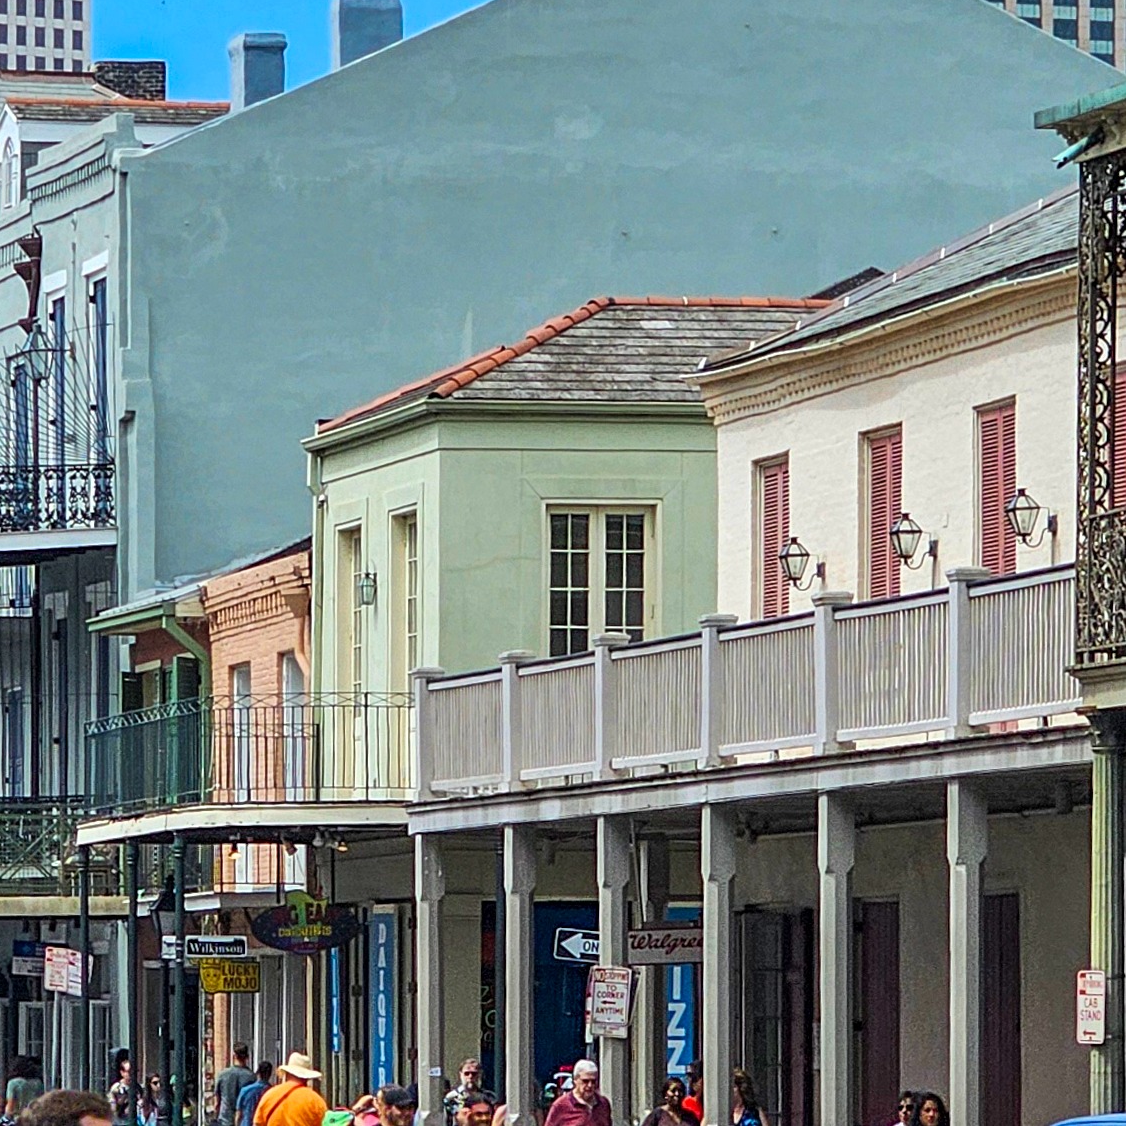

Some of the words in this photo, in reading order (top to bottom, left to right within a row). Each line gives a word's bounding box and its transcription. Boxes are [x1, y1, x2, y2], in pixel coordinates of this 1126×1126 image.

[189, 941, 244, 955] Wilkinson
[583, 941, 600, 953] ON
[629, 933, 703, 955] Walgree
[221, 964, 258, 976] LUCKY
[224, 977, 257, 989] MOJO
[606, 984, 617, 992] TO
[596, 991, 625, 999] CORNER
[378, 923, 387, 1088] DAIQUIR
[1084, 998, 1099, 1008] CAB
[595, 1007, 624, 1015] ANYTIME
[1080, 1009, 1102, 1021] STAND
[667, 966, 686, 1075] IZZ
